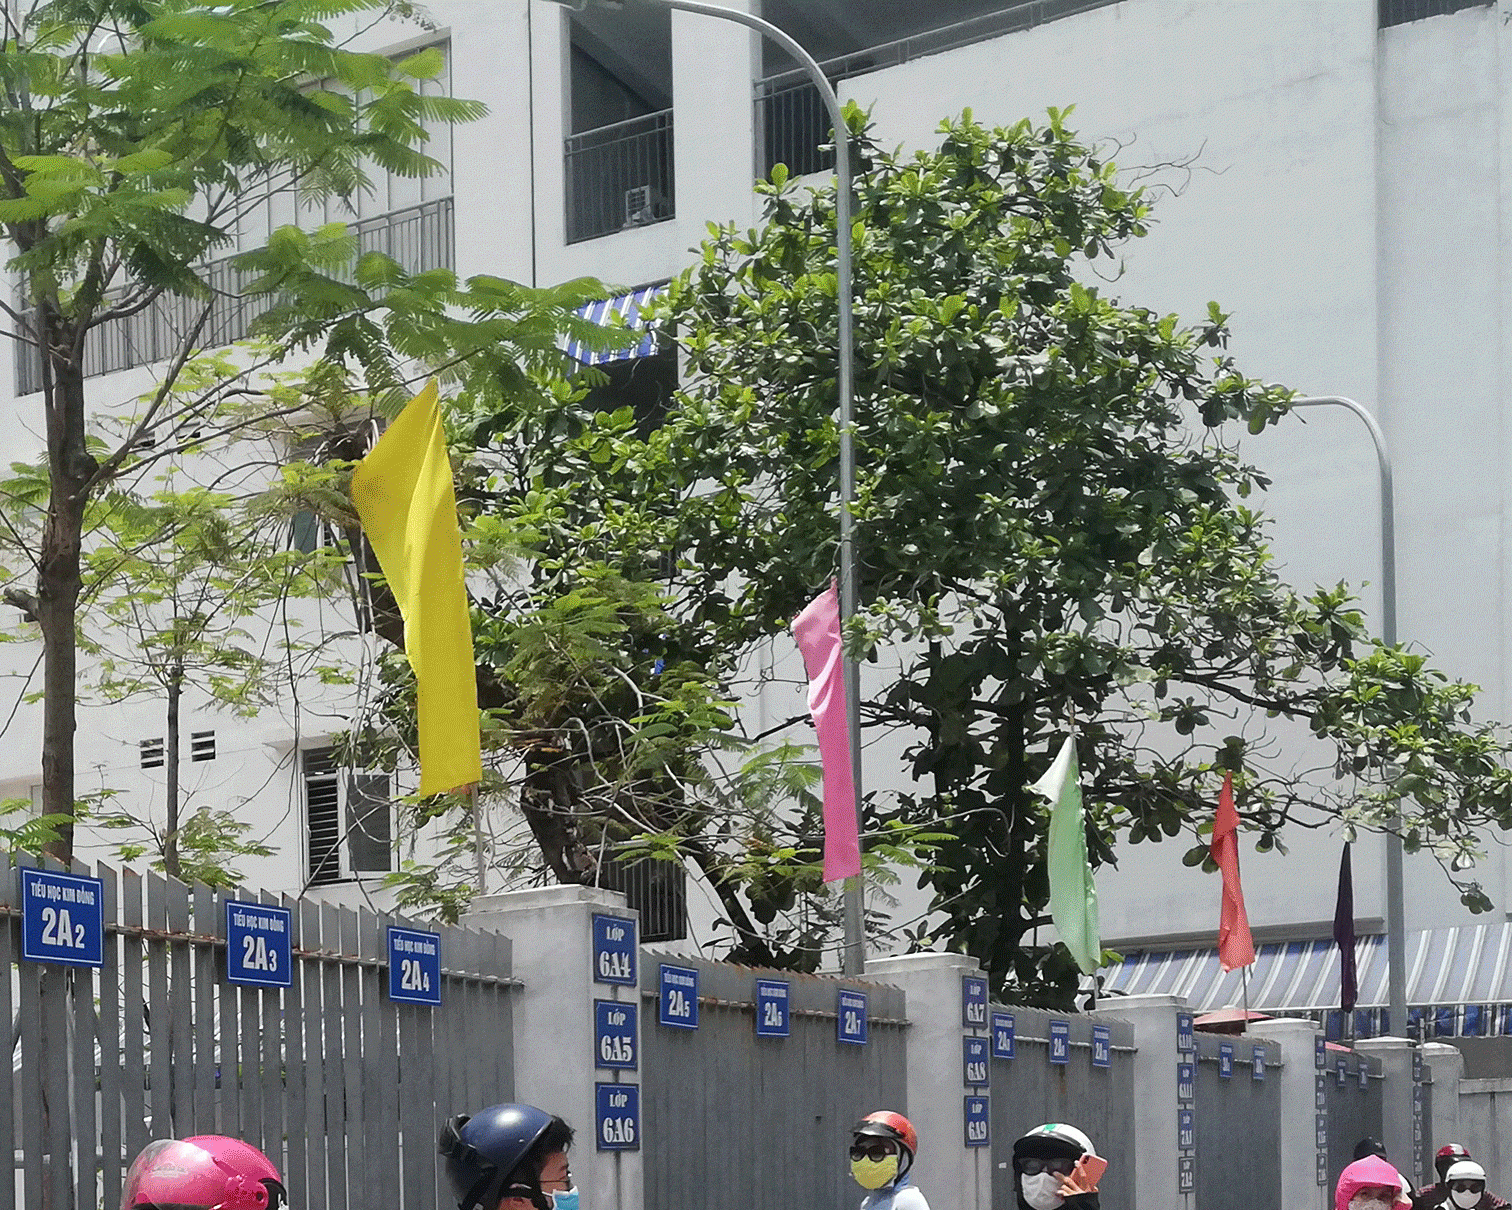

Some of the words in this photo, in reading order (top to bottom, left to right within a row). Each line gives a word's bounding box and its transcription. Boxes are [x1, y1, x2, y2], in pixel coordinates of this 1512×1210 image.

[41, 907, 85, 949] 2A2
[242, 935, 277, 972] 2A3
[599, 951, 631, 978] 6A4
[401, 959, 430, 992] 2A4
[668, 990, 690, 1017] 2A5
[967, 1002, 985, 1022] 6A7
[600, 1035, 633, 1062] 6A5
[967, 1061, 986, 1081] 6A8
[602, 1117, 634, 1143] 6A6
[968, 1121, 987, 1140] 6A9
